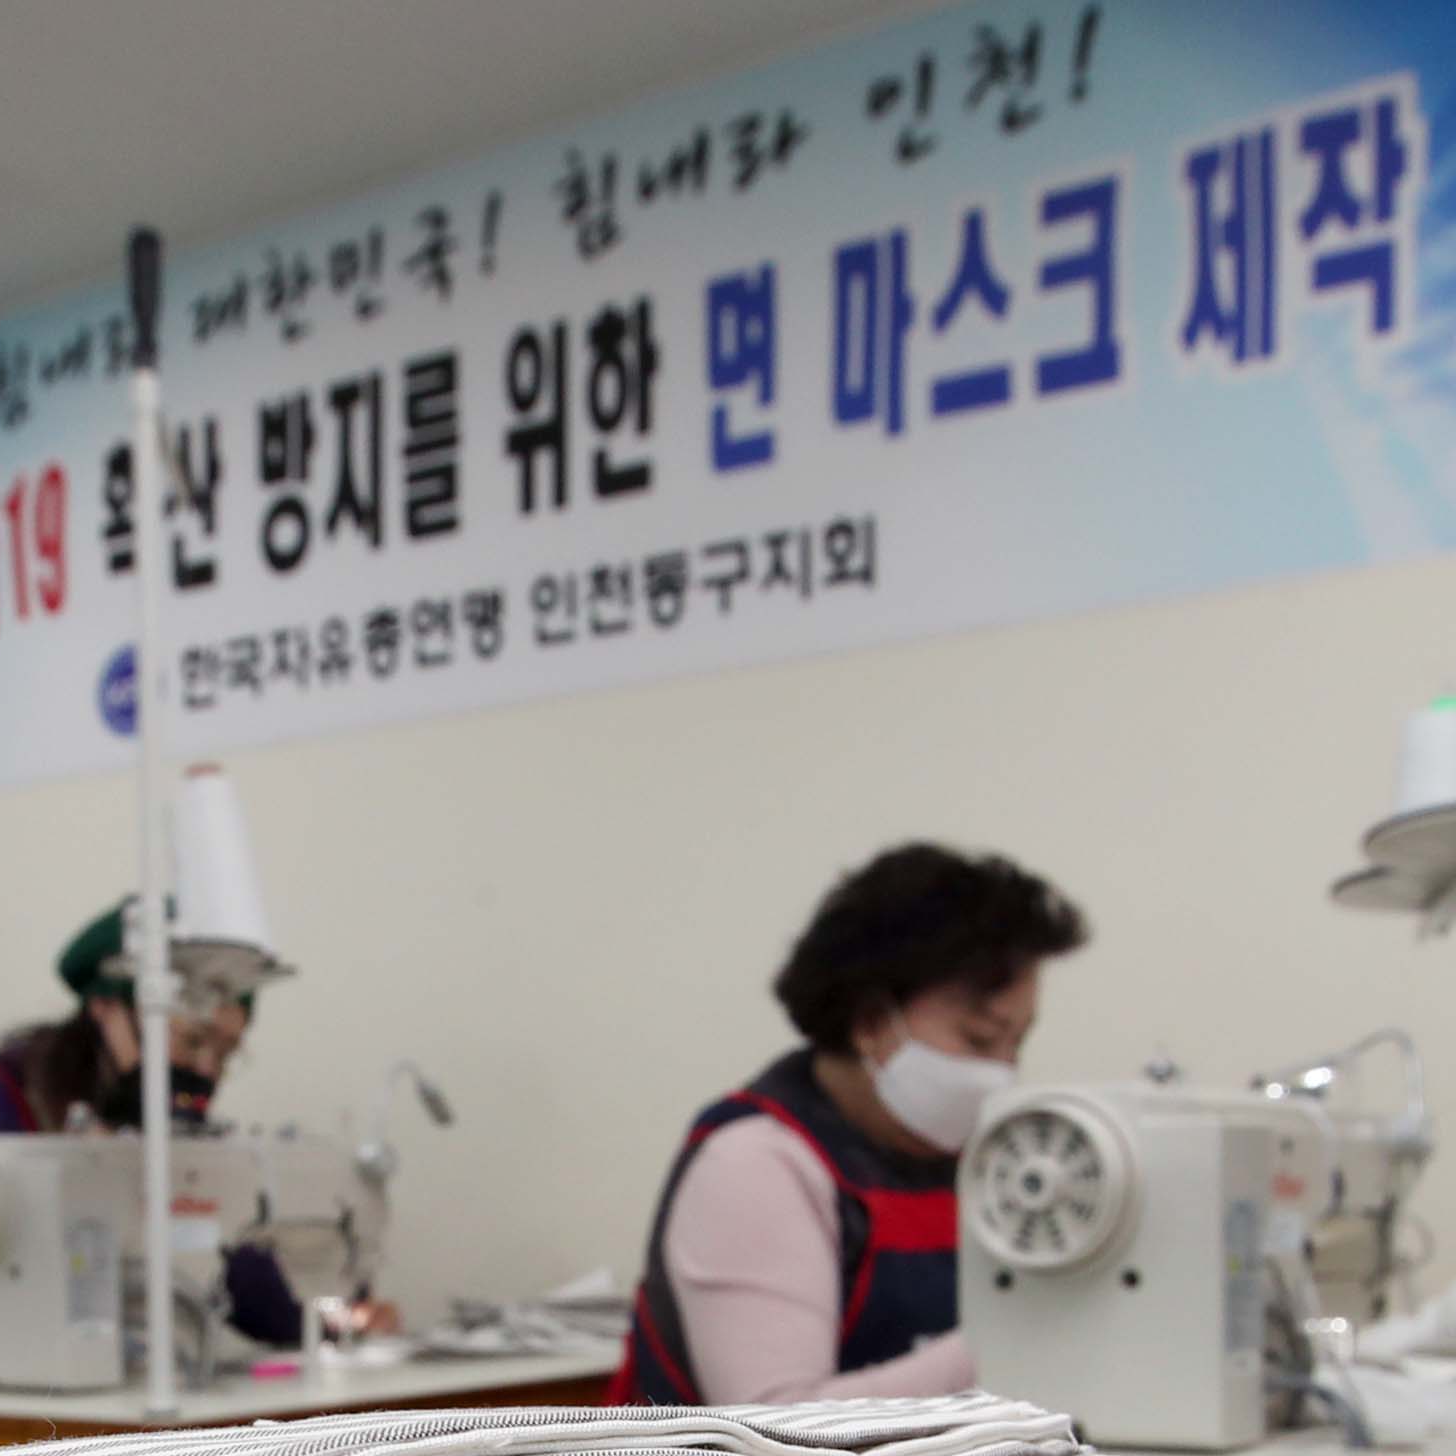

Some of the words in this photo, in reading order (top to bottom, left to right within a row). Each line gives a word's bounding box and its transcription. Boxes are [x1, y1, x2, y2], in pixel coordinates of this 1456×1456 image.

[189, 188, 504, 344] 대한민국!
[552, 106, 808, 263] 힘내라
[866, 3, 1104, 165] 인천!
[257, 352, 460, 575] 방지를
[504, 295, 660, 516] 위한
[704, 262, 778, 474] 면
[829, 175, 1122, 440] 마스크
[1180, 92, 1408, 366] 제작
[180, 588, 506, 708] 한국자유총연맹
[527, 514, 878, 648] 인천동구지회
